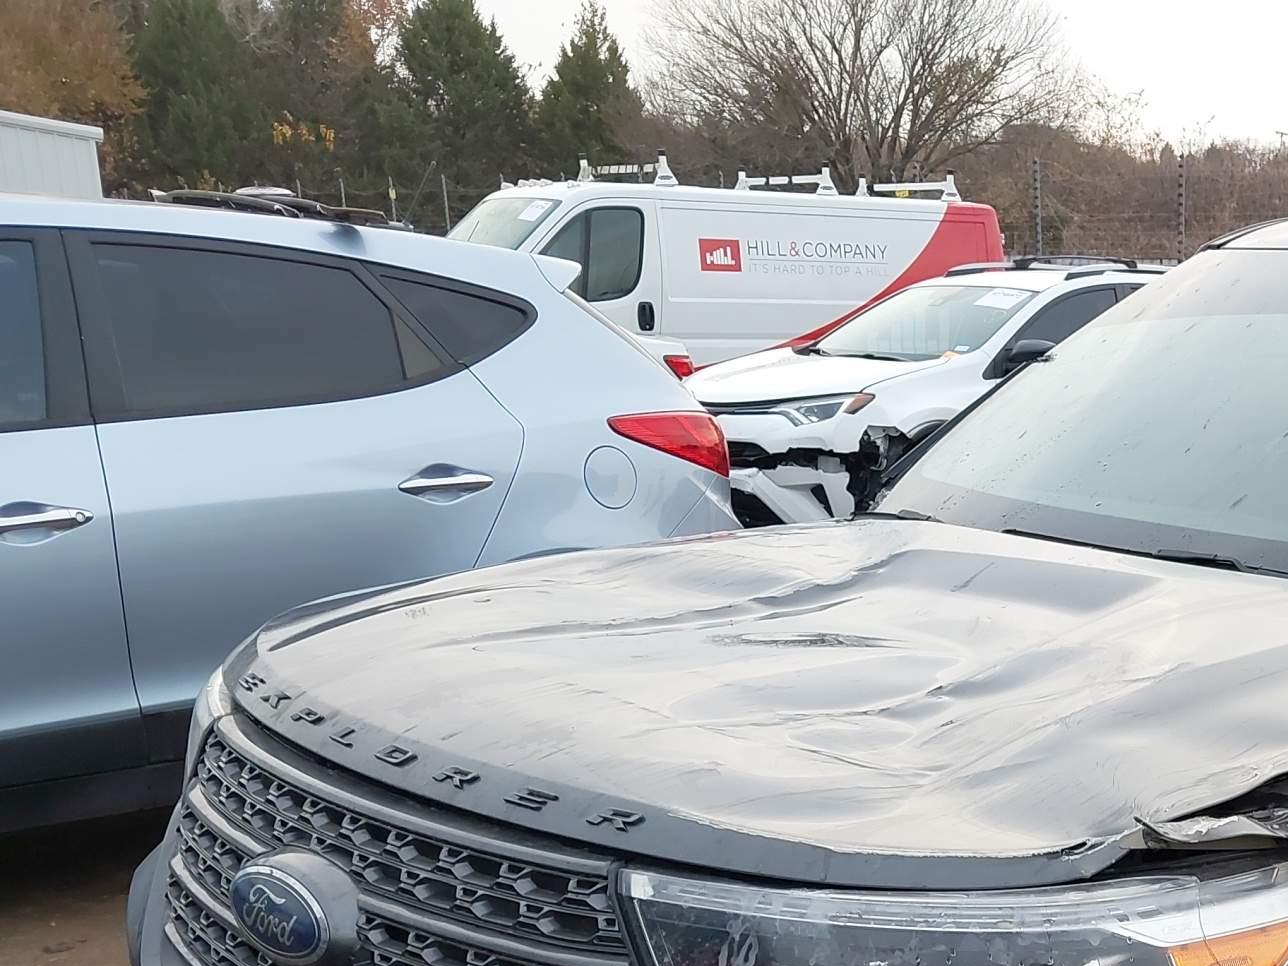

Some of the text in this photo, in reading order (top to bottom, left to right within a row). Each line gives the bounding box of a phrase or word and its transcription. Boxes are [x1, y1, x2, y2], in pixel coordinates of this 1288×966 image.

[747, 240, 888, 260] HILL&COMPANY
[748, 263, 770, 274] IT'S
[773, 264, 805, 276] HARD
[811, 265, 825, 276] TO
[829, 266, 850, 276] TOP
[855, 267, 863, 276] A
[238, 672, 648, 833] EXPLORER
[242, 884, 297, 946] Ford
